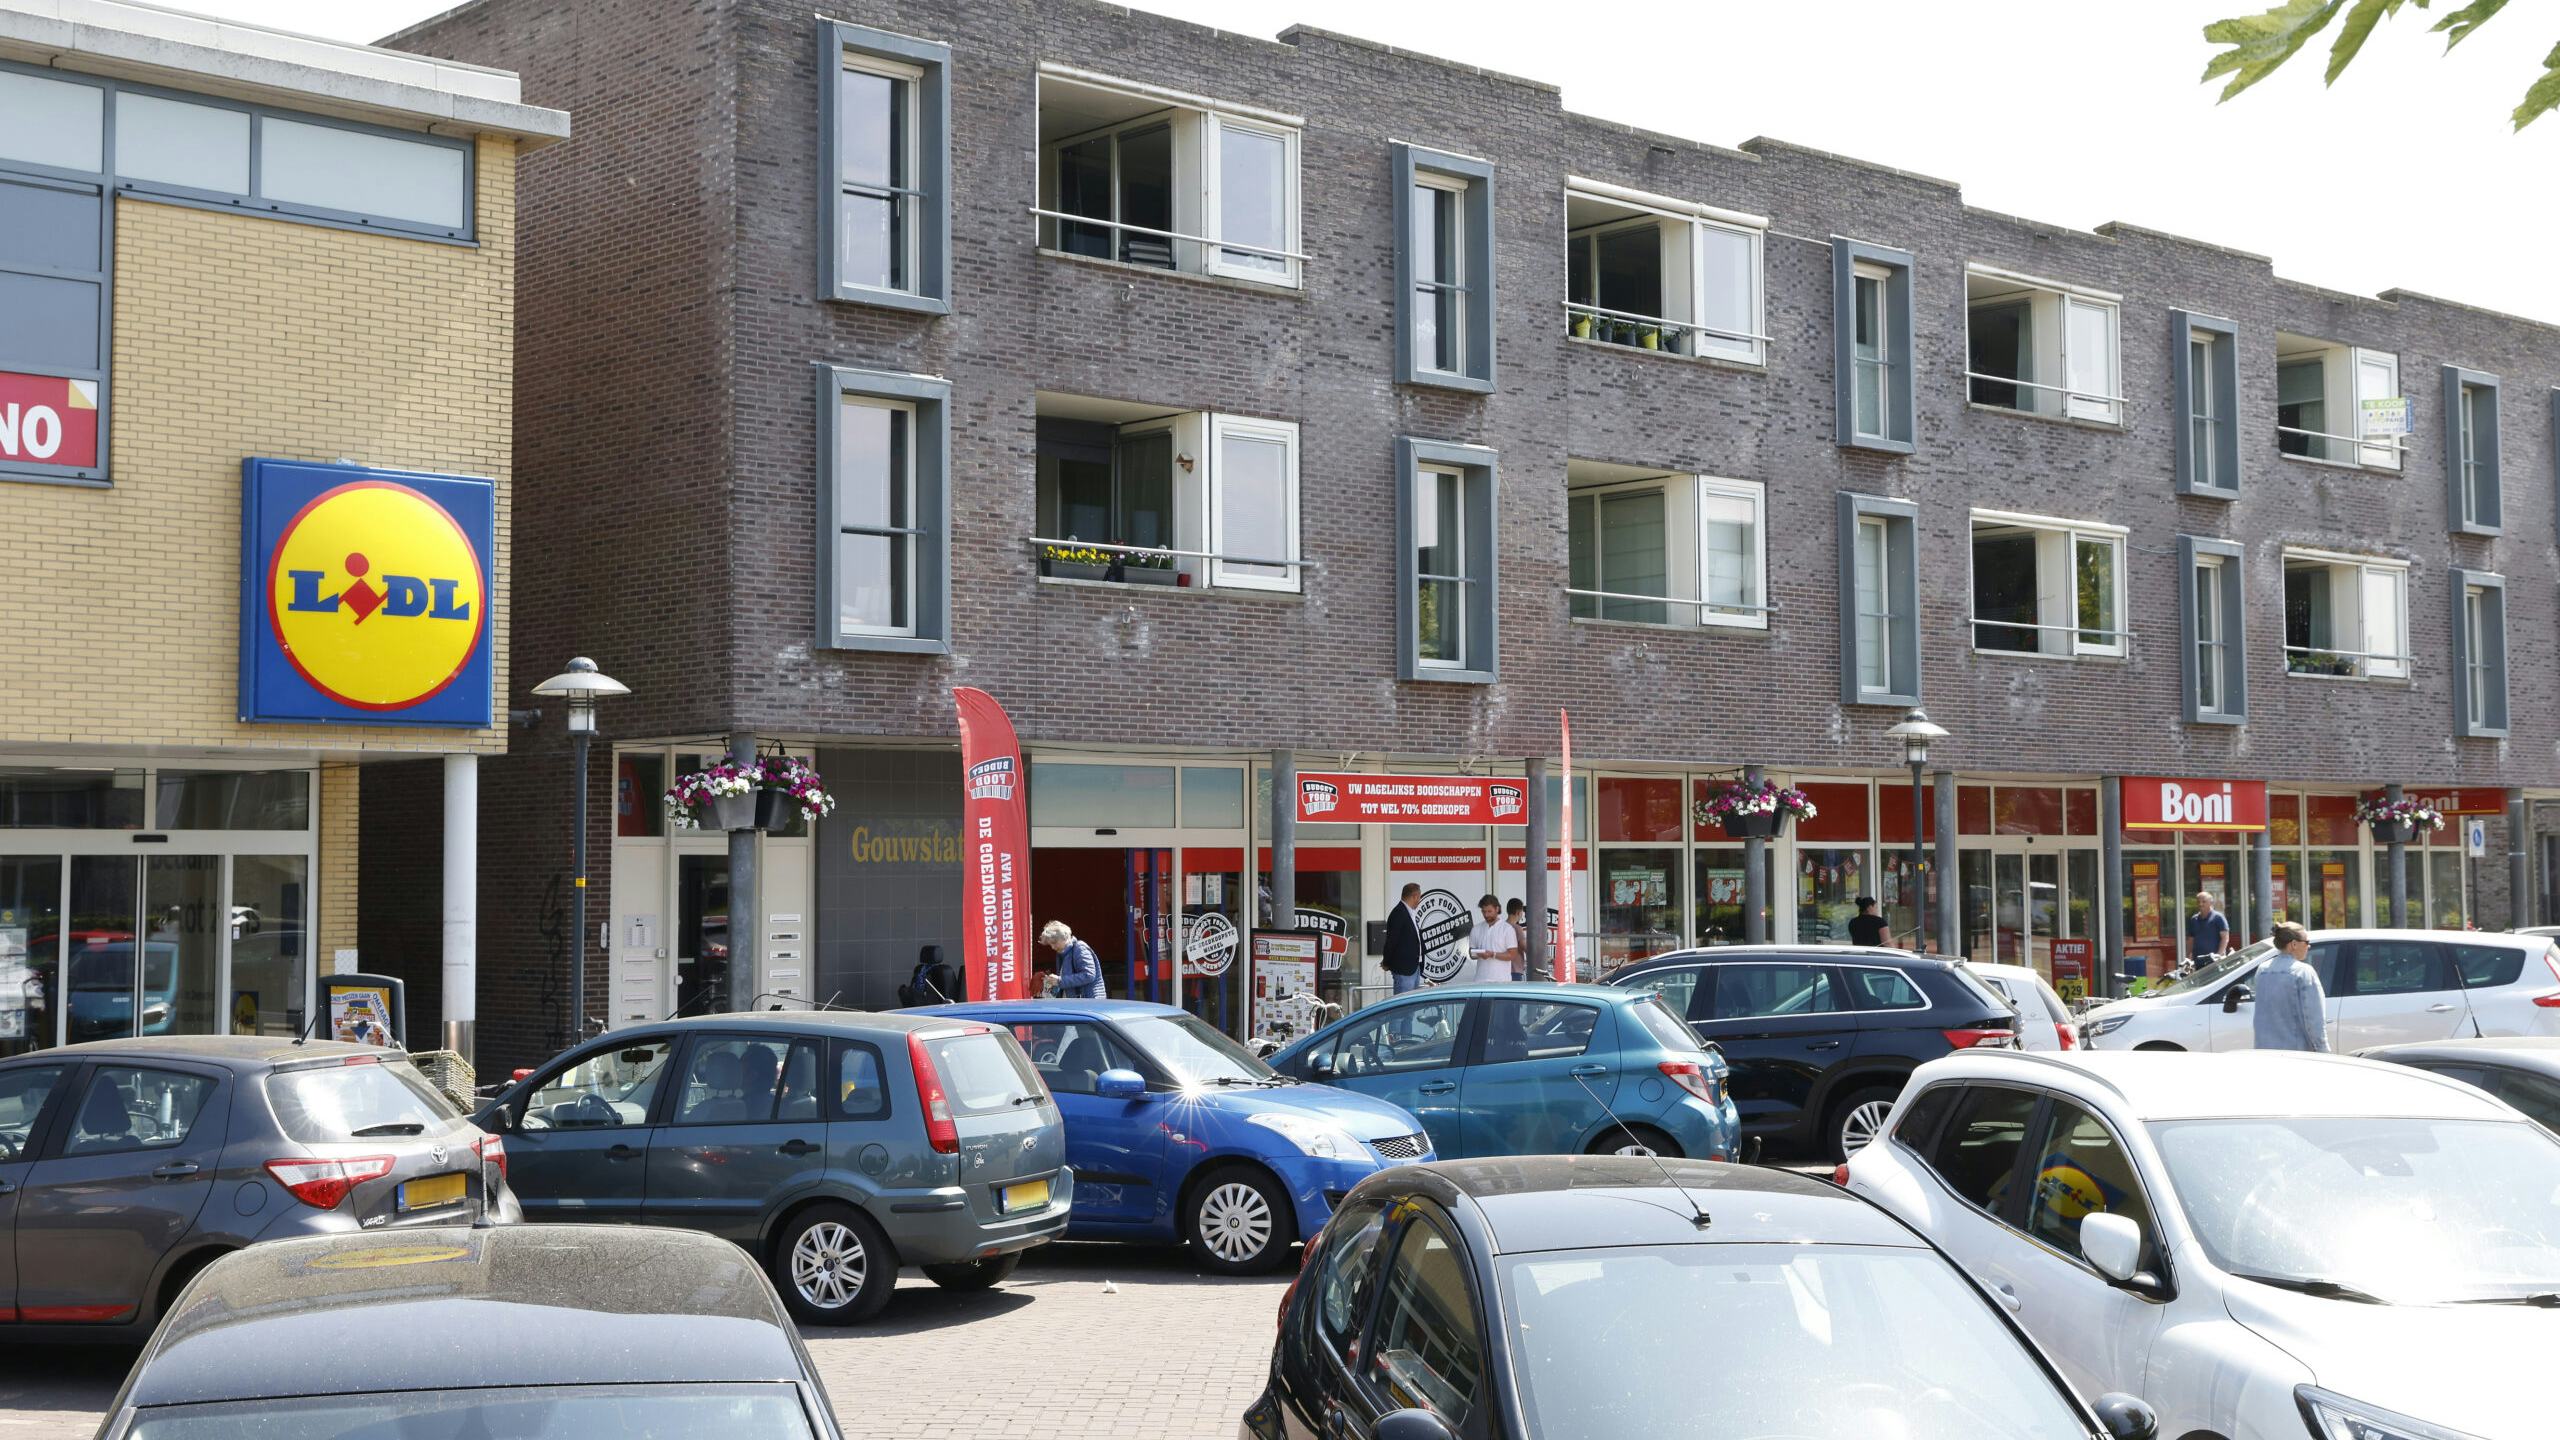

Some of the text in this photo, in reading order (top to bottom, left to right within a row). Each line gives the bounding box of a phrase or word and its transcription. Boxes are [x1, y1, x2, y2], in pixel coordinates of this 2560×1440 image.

[0, 403, 62, 458] NO
[1305, 783, 1334, 793] BUDGET
[1348, 784, 1482, 797] UW DAGELIJKSE BOODSCHAPPEN
[1493, 787, 1519, 797] BUDGET
[1308, 794, 1331, 802] FOOD
[1495, 796, 1516, 805] FOOD
[2161, 782, 2232, 823] Boni
[1360, 803, 1470, 815] TOT WEL 70% GOEDKOPER
[1403, 856, 1437, 864] DAGELIJKSE
[1437, 856, 1481, 864] BOODSCHAPPEN
[1415, 898, 1457, 923] UDGET FOOD
[1422, 914, 1470, 941] OEDKOOPSTE
[1424, 932, 1454, 950] WINKEL
[1203, 942, 1224, 953] WINKEL
[1436, 949, 1447, 957] VAN
[2055, 943, 2085, 954] AKTIE!
[1425, 948, 1461, 974] ZEEWOLDE
